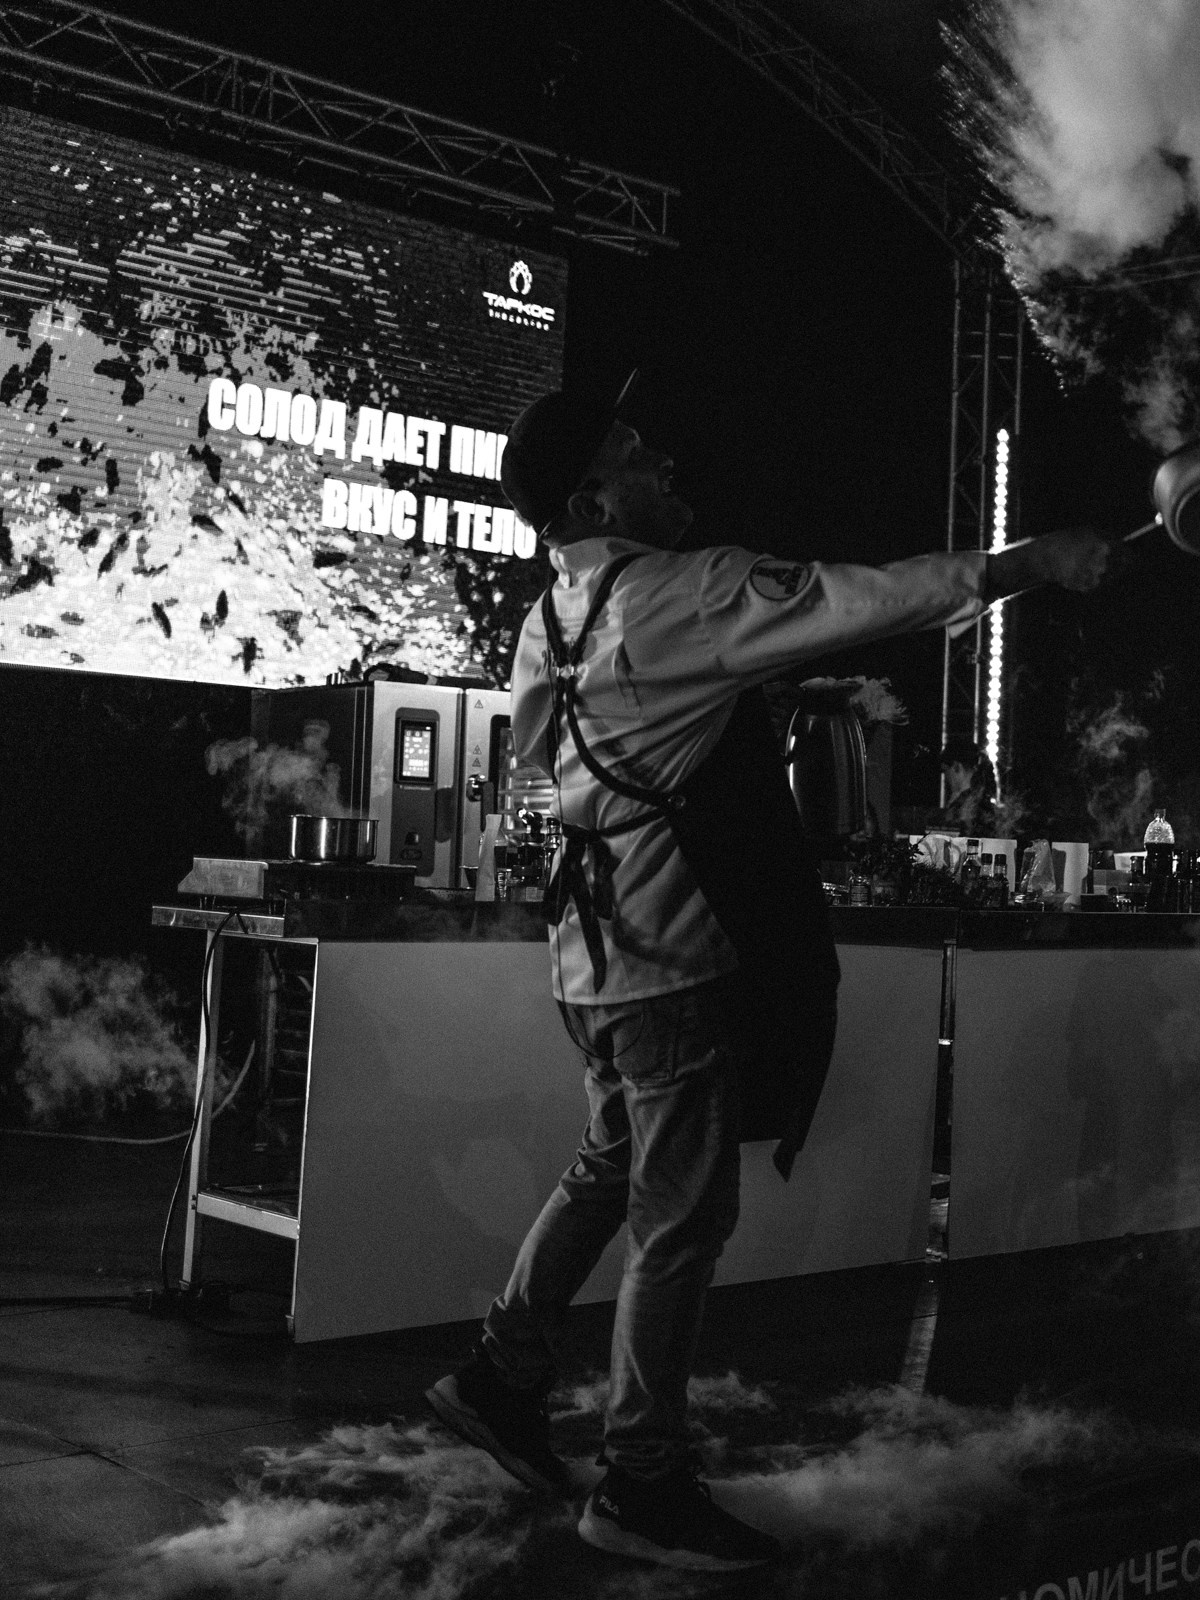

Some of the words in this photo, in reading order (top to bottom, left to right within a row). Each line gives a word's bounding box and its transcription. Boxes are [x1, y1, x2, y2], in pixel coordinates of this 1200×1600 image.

[207, 377, 347, 459] СОЛОД
[351, 406, 447, 470] ДАЕТ
[322, 478, 417, 541] ВКУС
[423, 495, 449, 546] И
[453, 500, 537, 560] ТЕЛО
[600, 1495, 619, 1515] FILA
